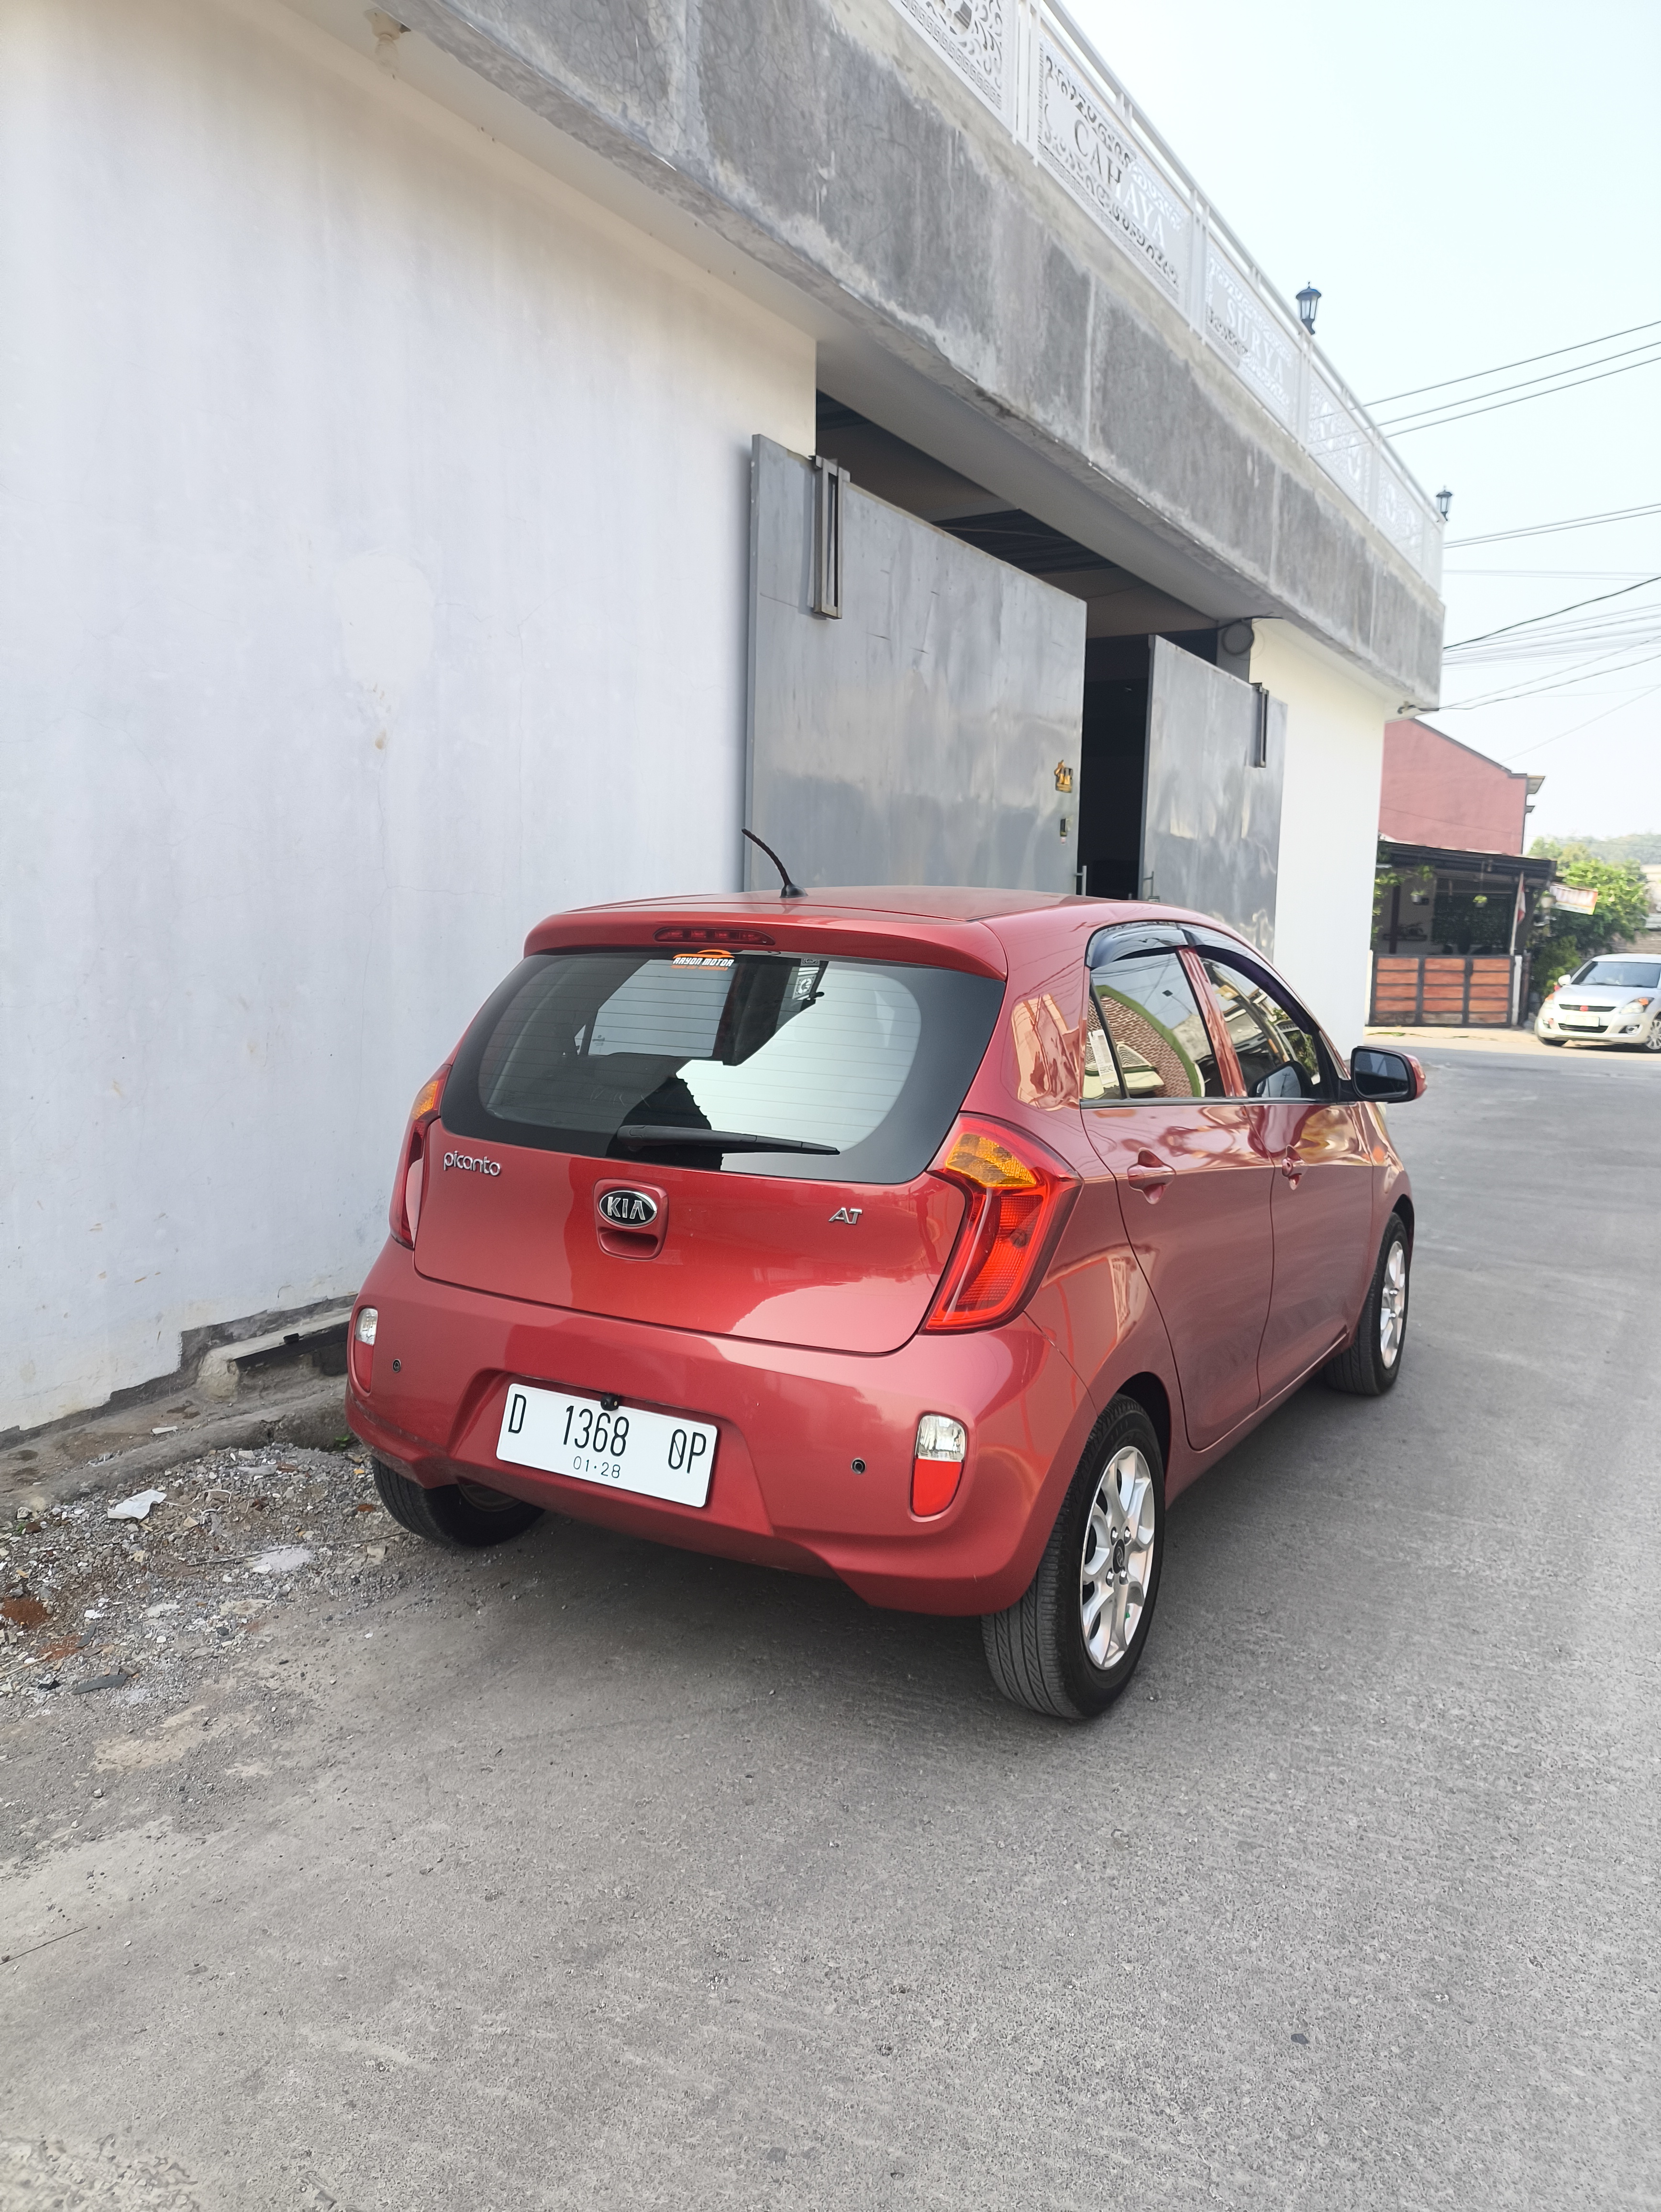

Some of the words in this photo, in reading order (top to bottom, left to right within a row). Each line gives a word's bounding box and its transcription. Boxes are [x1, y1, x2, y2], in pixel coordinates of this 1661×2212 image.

[1074, 120, 1166, 250] CAHAYA
[1227, 298, 1284, 385] SURYA
[701, 958, 734, 967] MOTOR
[443, 1150, 501, 1176] picanto
[607, 1196, 646, 1220] KIA
[828, 1207, 863, 1225] AT
[508, 1394, 527, 1433] D
[563, 1405, 630, 1457] 1368
